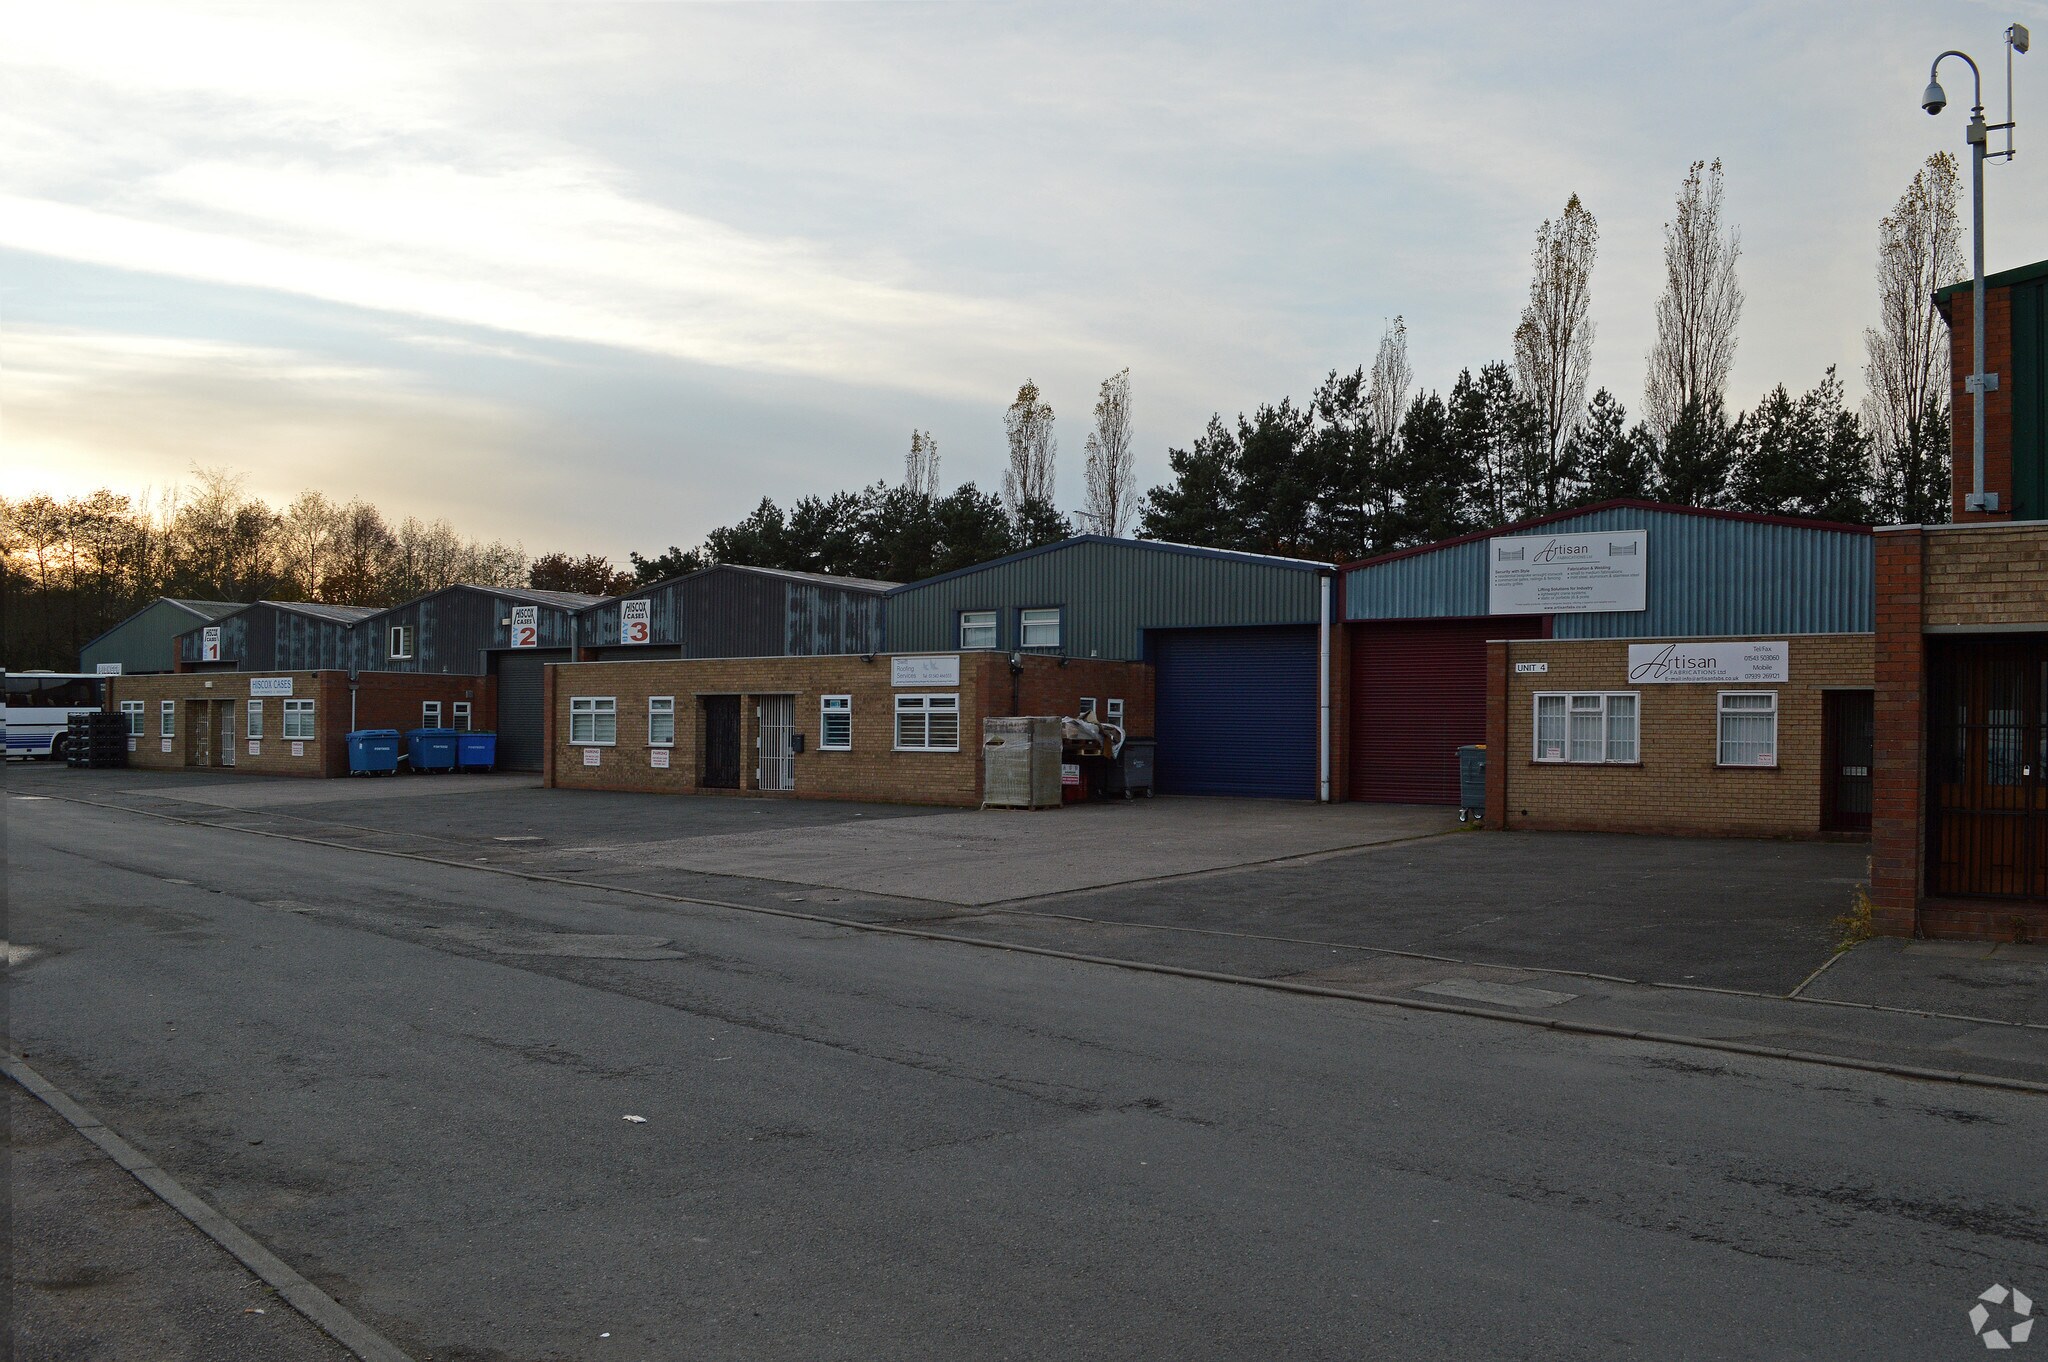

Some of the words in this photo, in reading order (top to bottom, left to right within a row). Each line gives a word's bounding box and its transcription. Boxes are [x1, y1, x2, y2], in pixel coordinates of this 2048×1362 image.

[1533, 539, 1588, 562] Artisan
[514, 608, 535, 625] HISCOX
[623, 601, 648, 619] HISCOX
[520, 627, 535, 645] 2
[630, 621, 648, 641] 3
[210, 644, 217, 659] 1
[1630, 644, 1717, 679] Artisan
[252, 680, 272, 689] HISCOX
[273, 680, 291, 689] CASES
